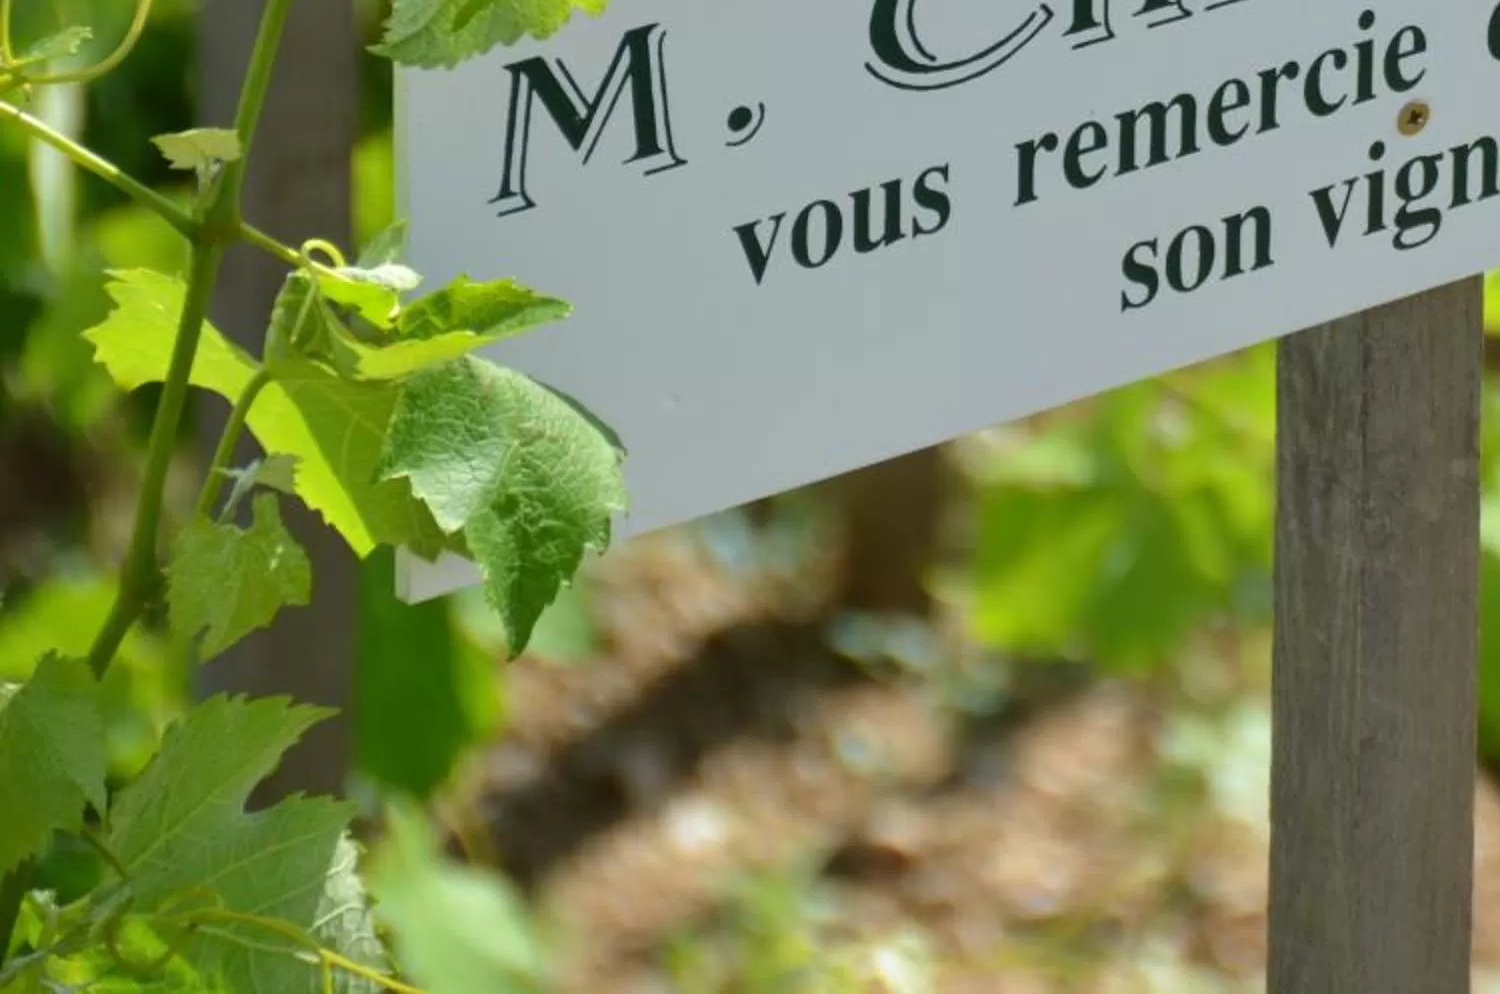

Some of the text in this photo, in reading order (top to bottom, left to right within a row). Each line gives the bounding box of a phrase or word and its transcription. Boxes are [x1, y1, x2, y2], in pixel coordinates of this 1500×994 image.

[486, 21, 766, 218] M.
[732, 162, 952, 286] vous
[1011, 8, 1428, 208] remercie
[1120, 205, 1275, 312] son
